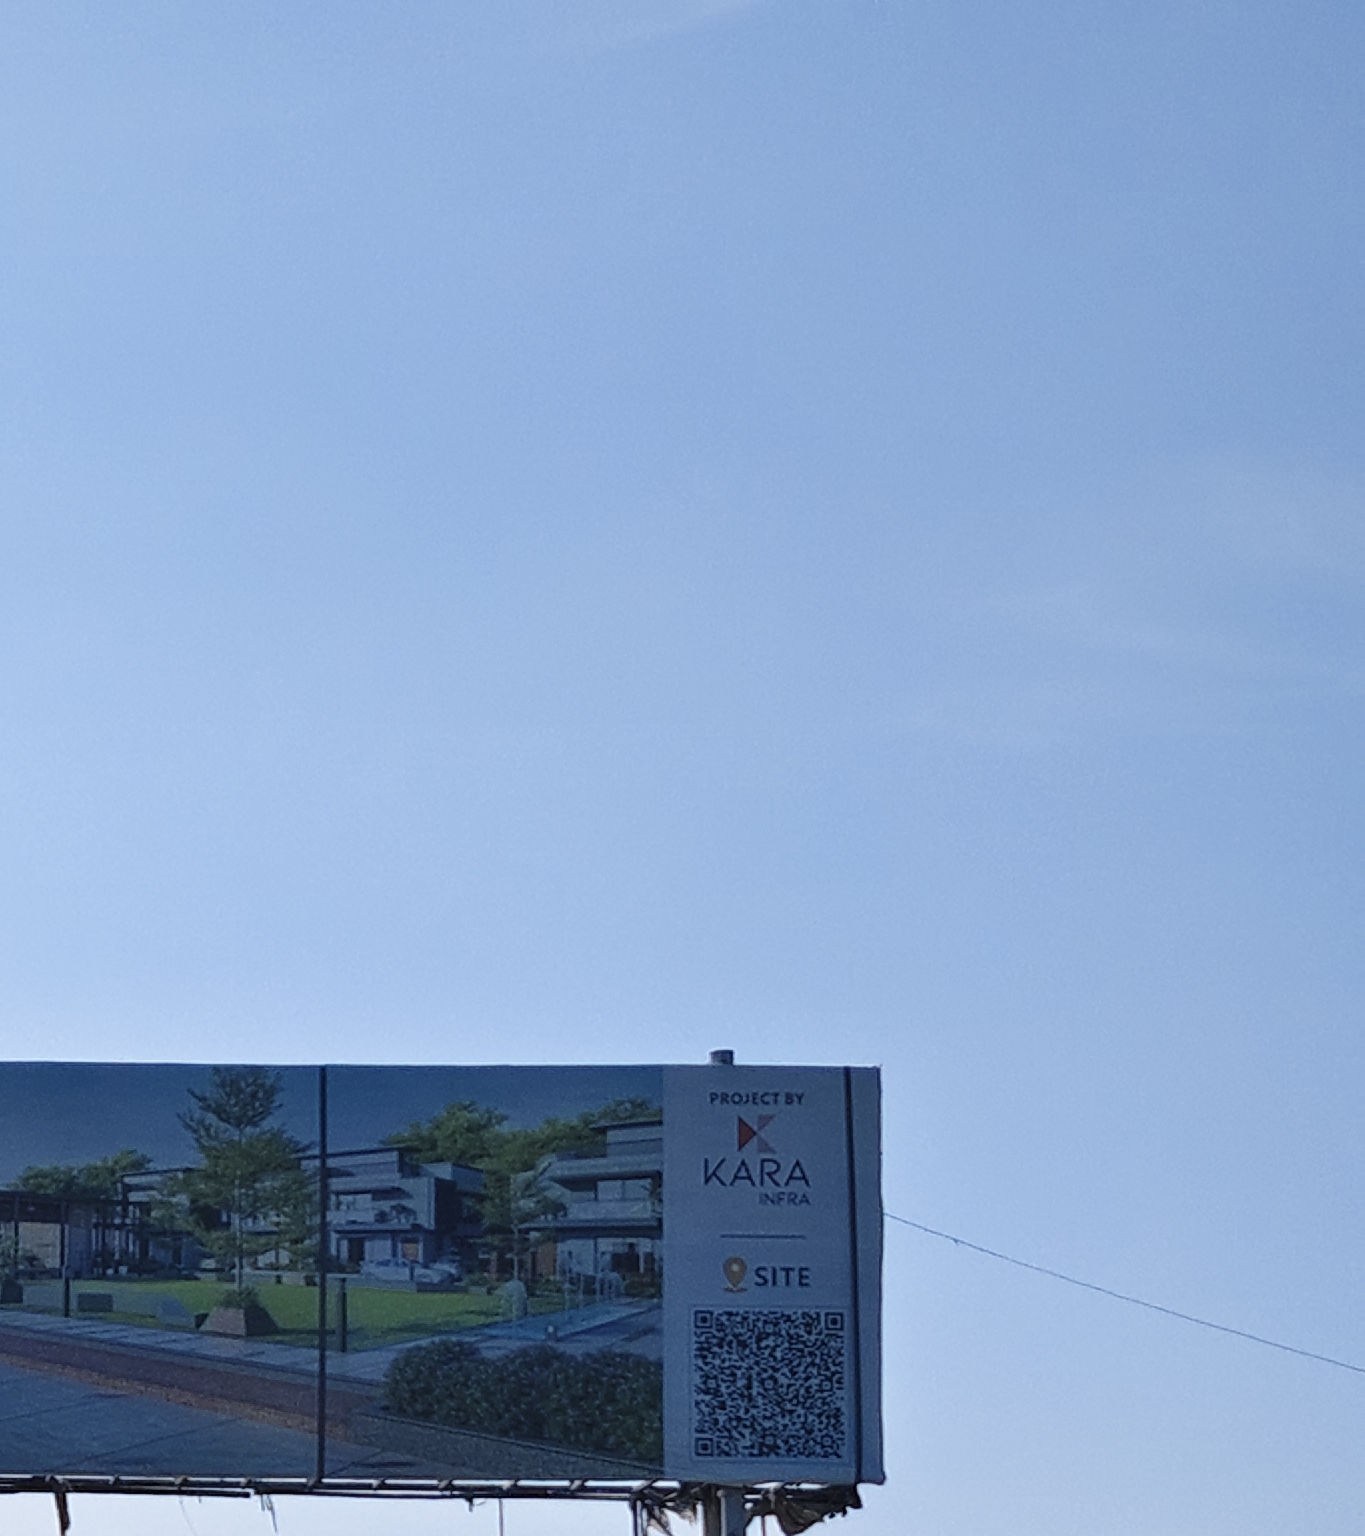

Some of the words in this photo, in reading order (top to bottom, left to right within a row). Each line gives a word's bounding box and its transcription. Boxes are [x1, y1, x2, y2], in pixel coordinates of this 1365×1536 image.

[709, 1092, 780, 1105] PROJECT
[784, 1092, 805, 1105] BY
[703, 1158, 812, 1187] KARA
[758, 1191, 812, 1206] INFRA
[754, 1266, 812, 1287] SITE
